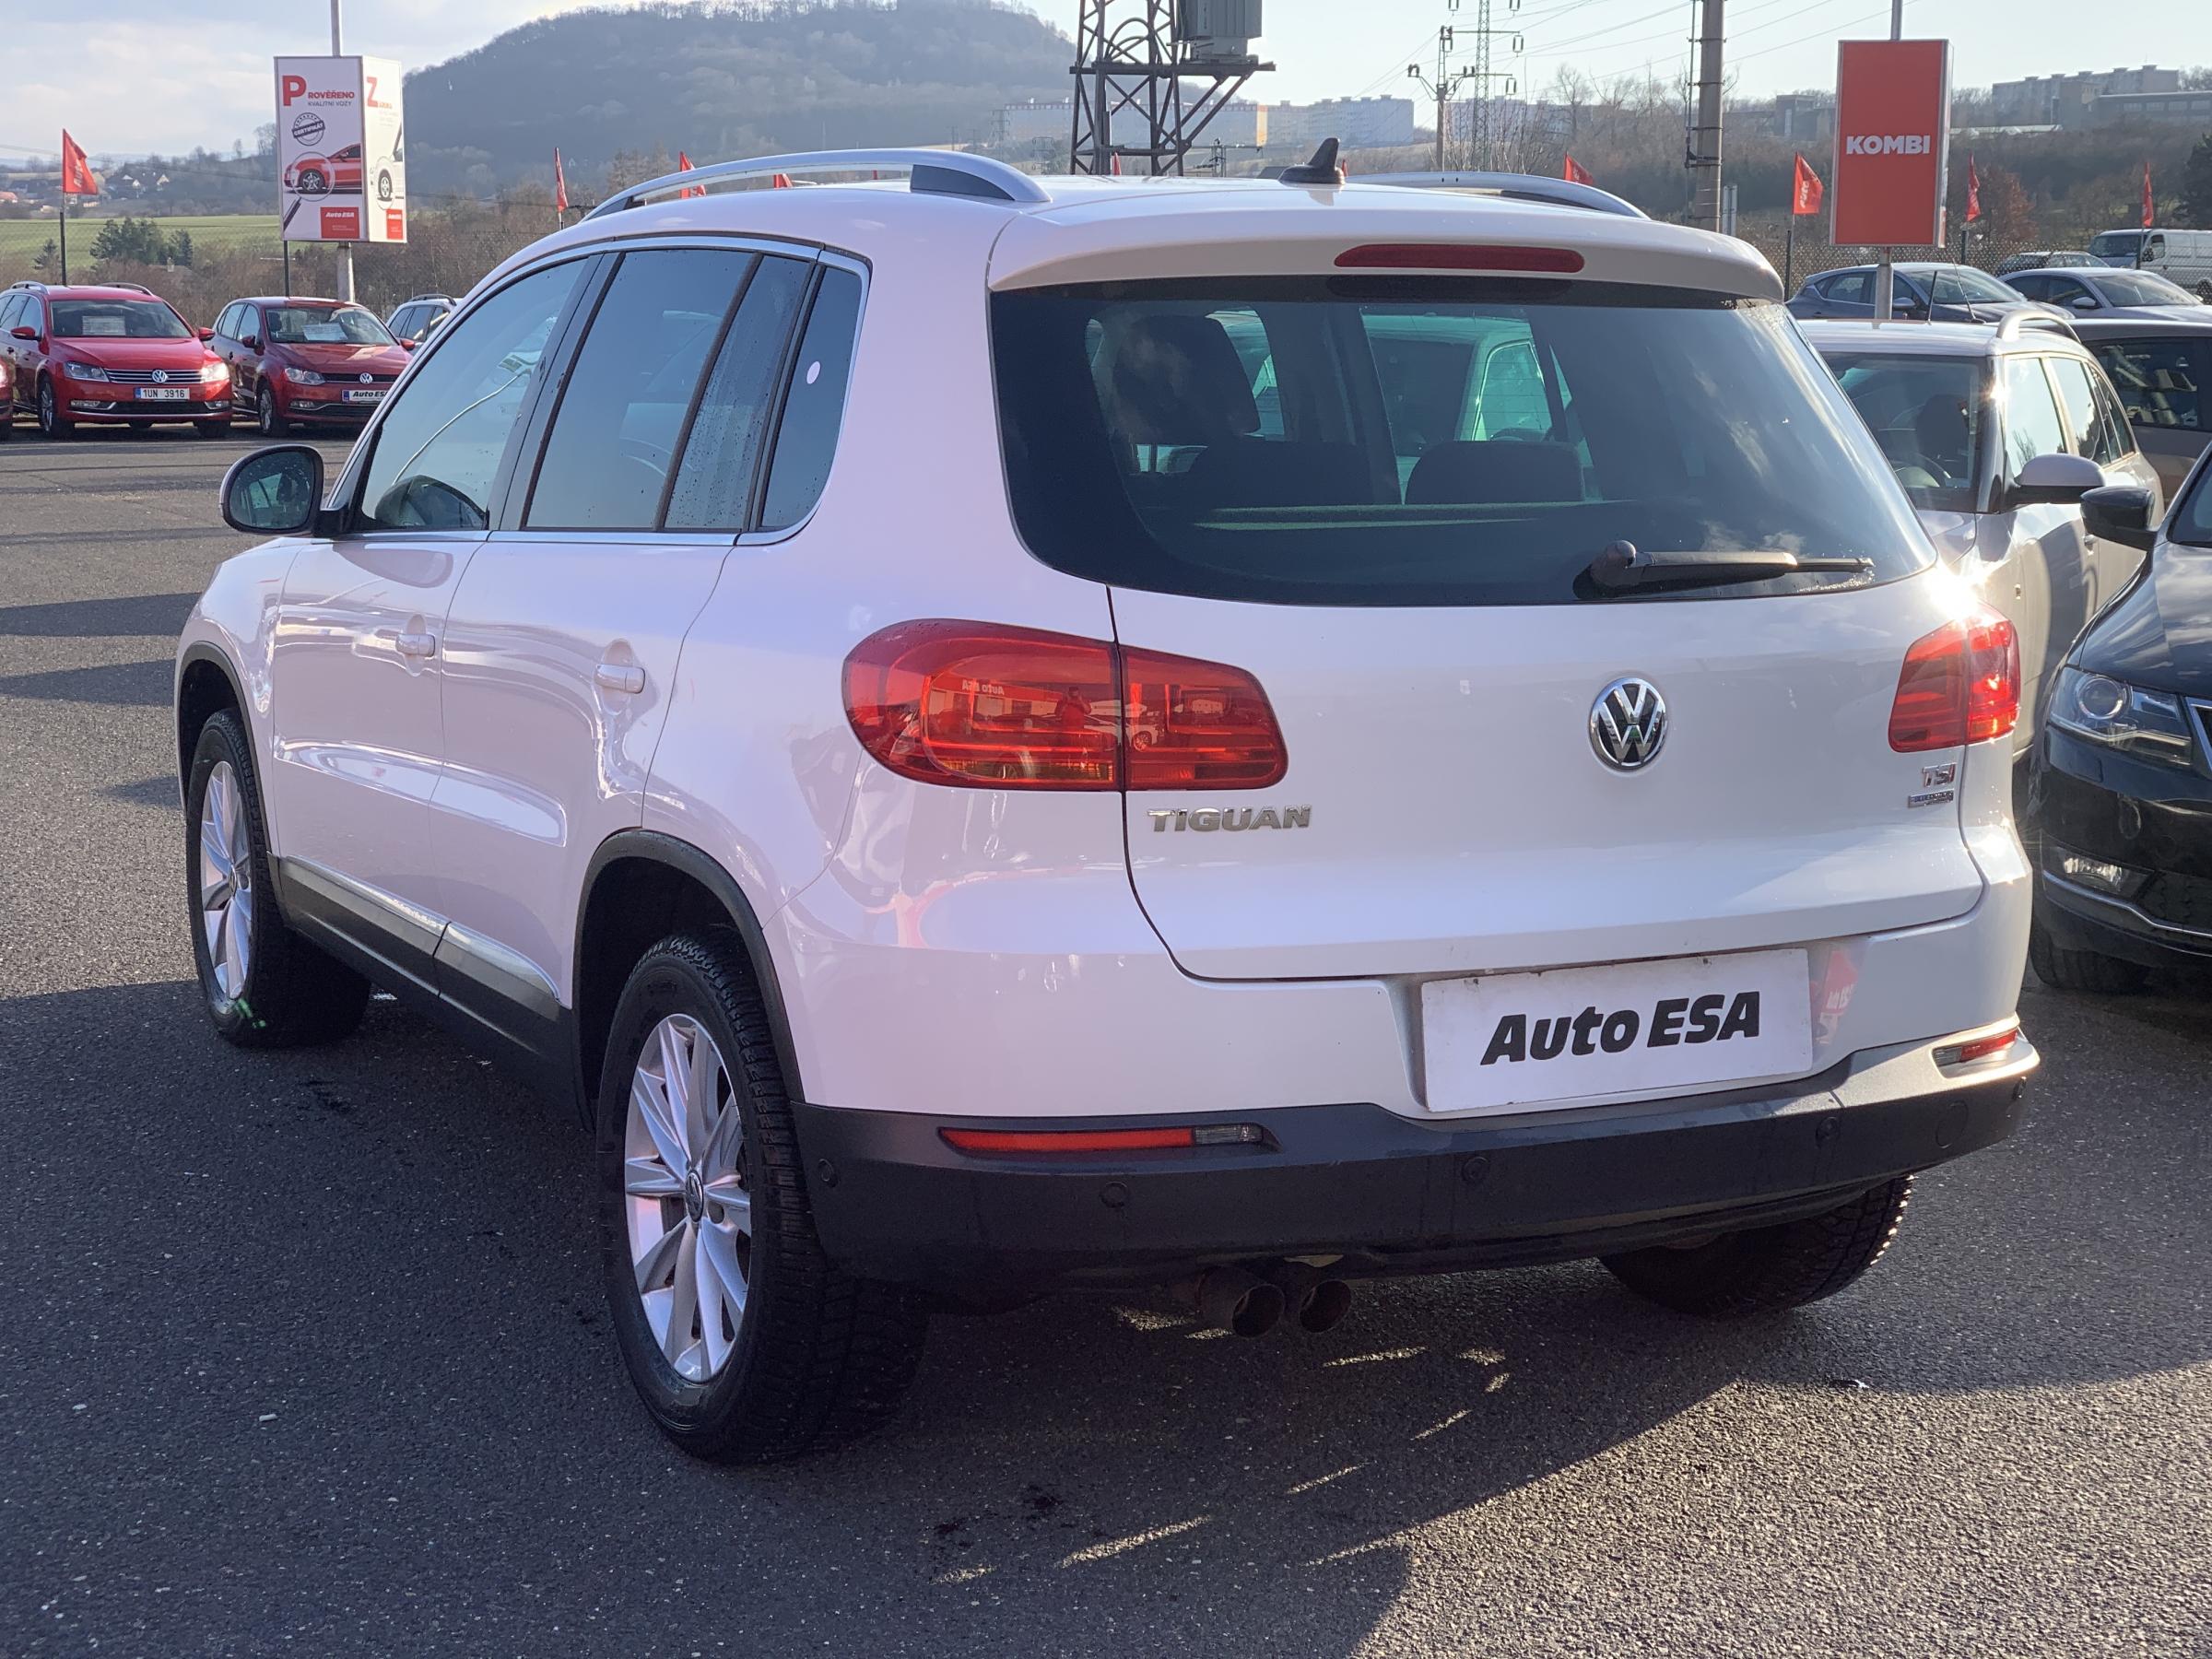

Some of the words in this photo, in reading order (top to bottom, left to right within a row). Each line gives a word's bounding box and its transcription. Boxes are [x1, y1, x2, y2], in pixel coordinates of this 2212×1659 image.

[1846, 135, 1931, 155] KOMBI
[143, 389, 158, 397] 1UN
[164, 389, 185, 397] 3916
[1922, 762, 1957, 787] TSI
[1147, 805, 1312, 832] TIGUAN
[1479, 1006, 1641, 1066] Auto
[1646, 991, 1760, 1049] ESA
